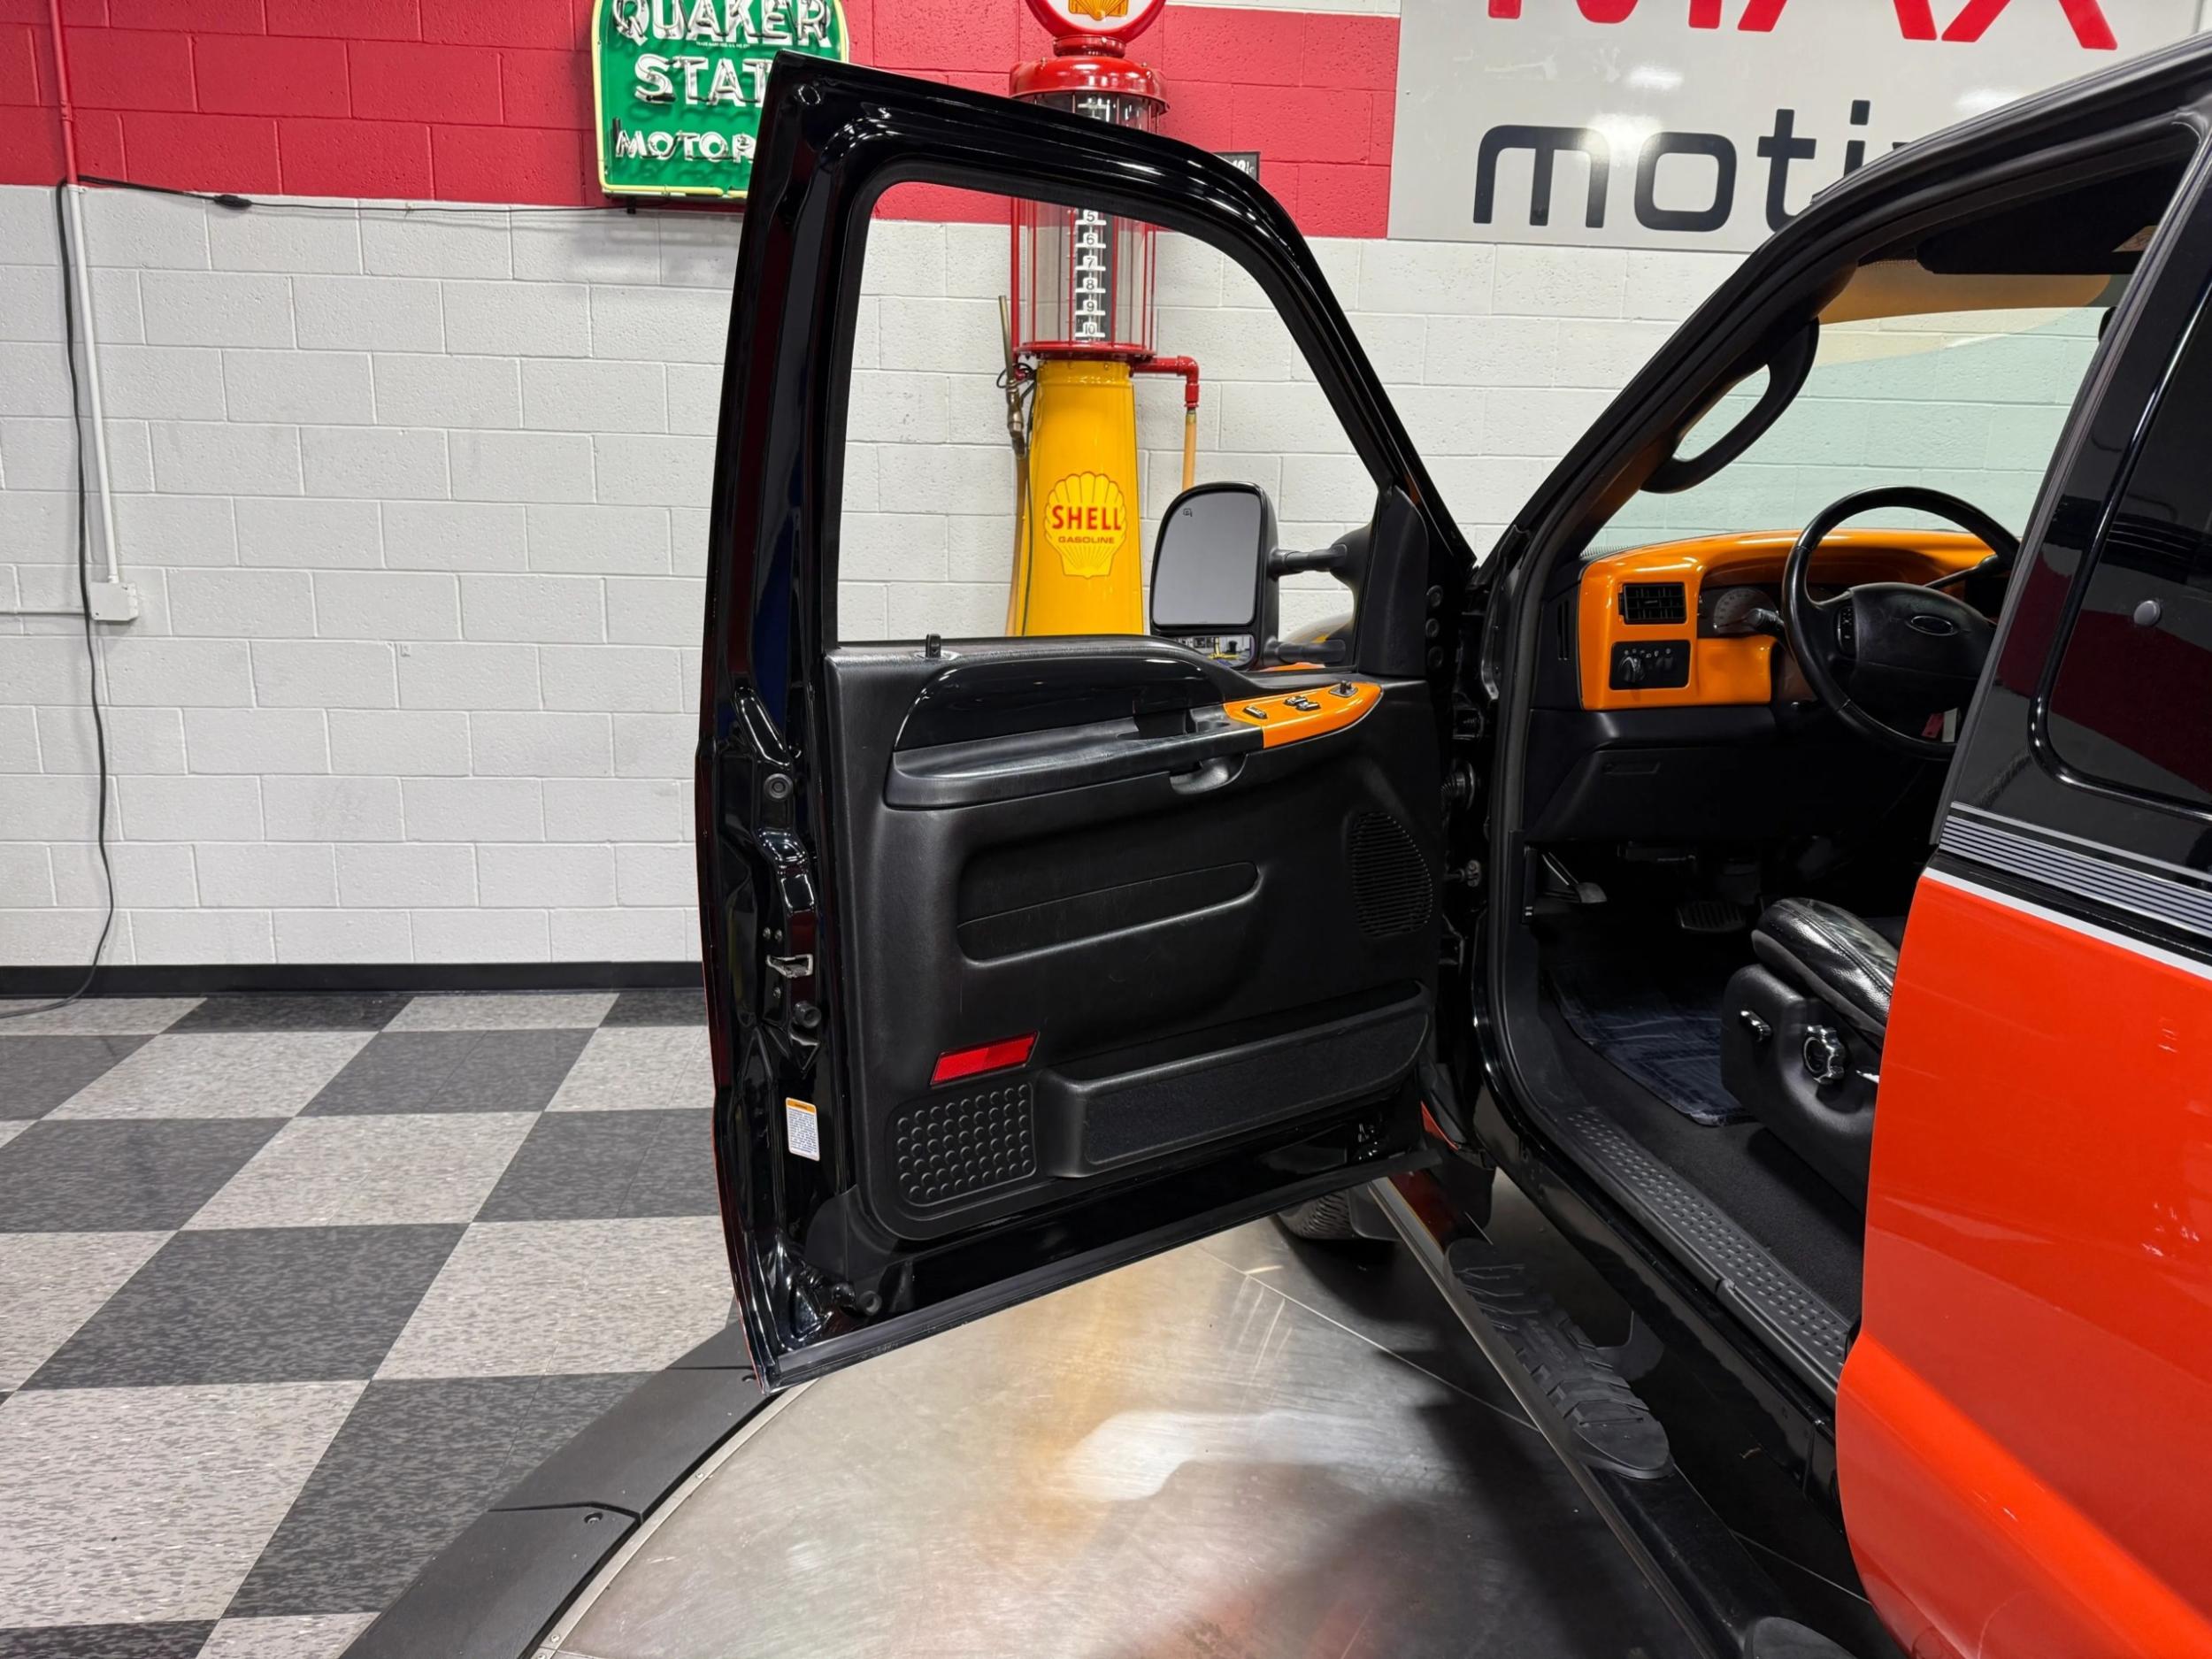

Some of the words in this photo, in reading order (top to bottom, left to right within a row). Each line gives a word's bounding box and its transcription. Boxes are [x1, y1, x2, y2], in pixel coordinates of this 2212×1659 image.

[612, 0, 832, 47] QUAKER
[634, 53, 772, 107] STAT
[1473, 99, 1912, 232] moti
[1087, 211, 1095, 221] 5
[1087, 234, 1094, 245] 6
[1087, 257, 1094, 266] 7
[1087, 279, 1094, 290] 8
[1087, 301, 1094, 311] 9
[1085, 324, 1095, 334] 10
[1052, 505, 1122, 530] SHELL
